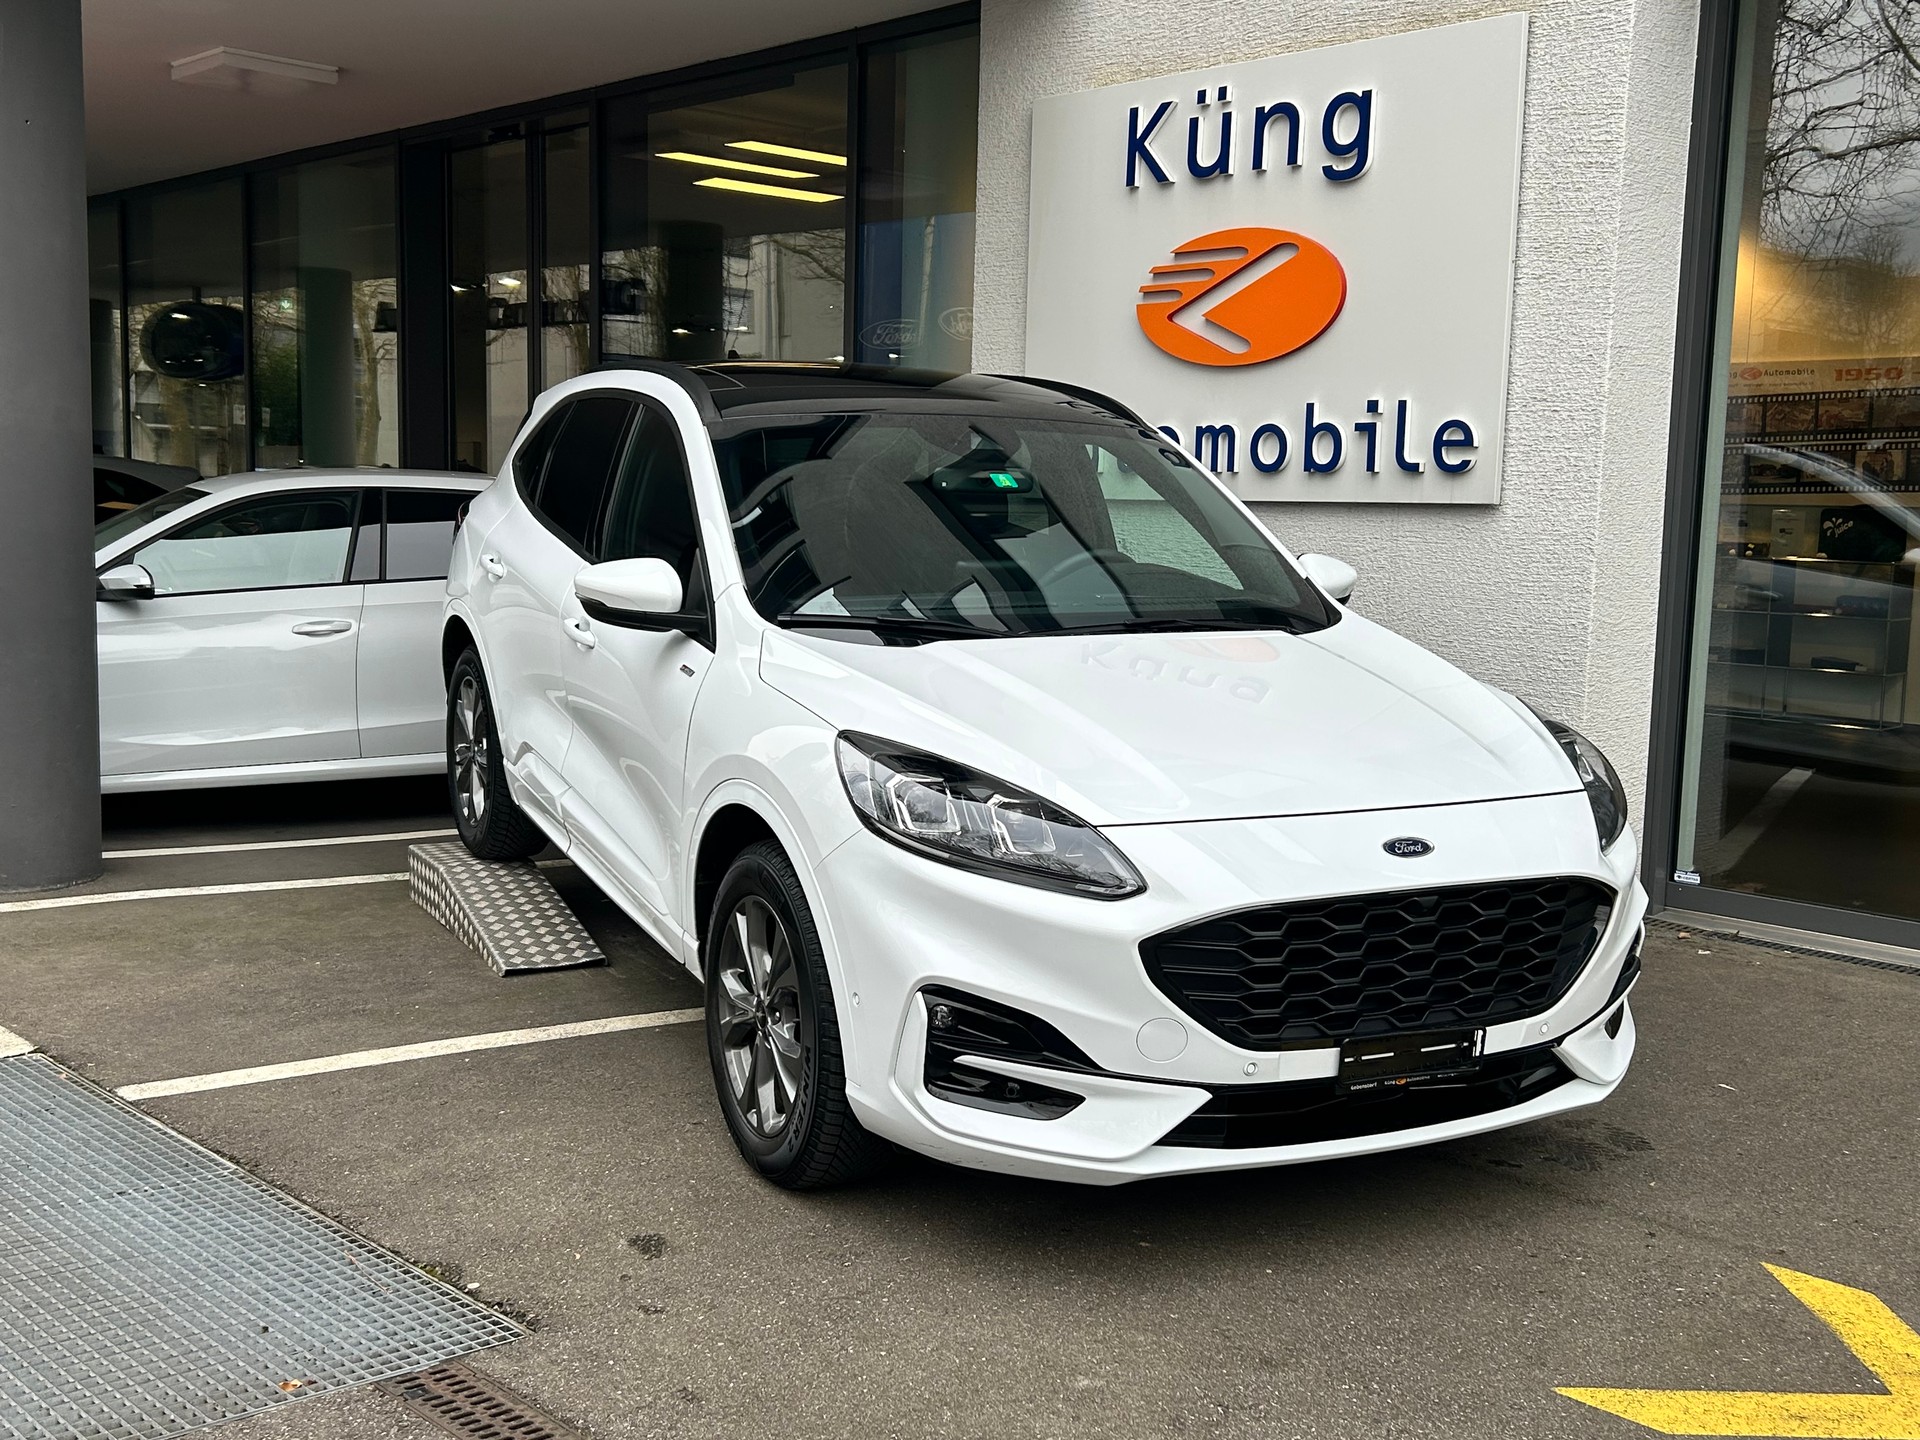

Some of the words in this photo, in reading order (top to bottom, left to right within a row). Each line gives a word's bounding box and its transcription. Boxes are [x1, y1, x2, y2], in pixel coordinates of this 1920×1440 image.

[1125, 85, 1377, 187] Küng
[1763, 367, 1816, 377] Automobile
[1834, 366, 1904, 382] 1950
[1156, 398, 1478, 474] mobile
[793, 1045, 811, 1142] WINTER
